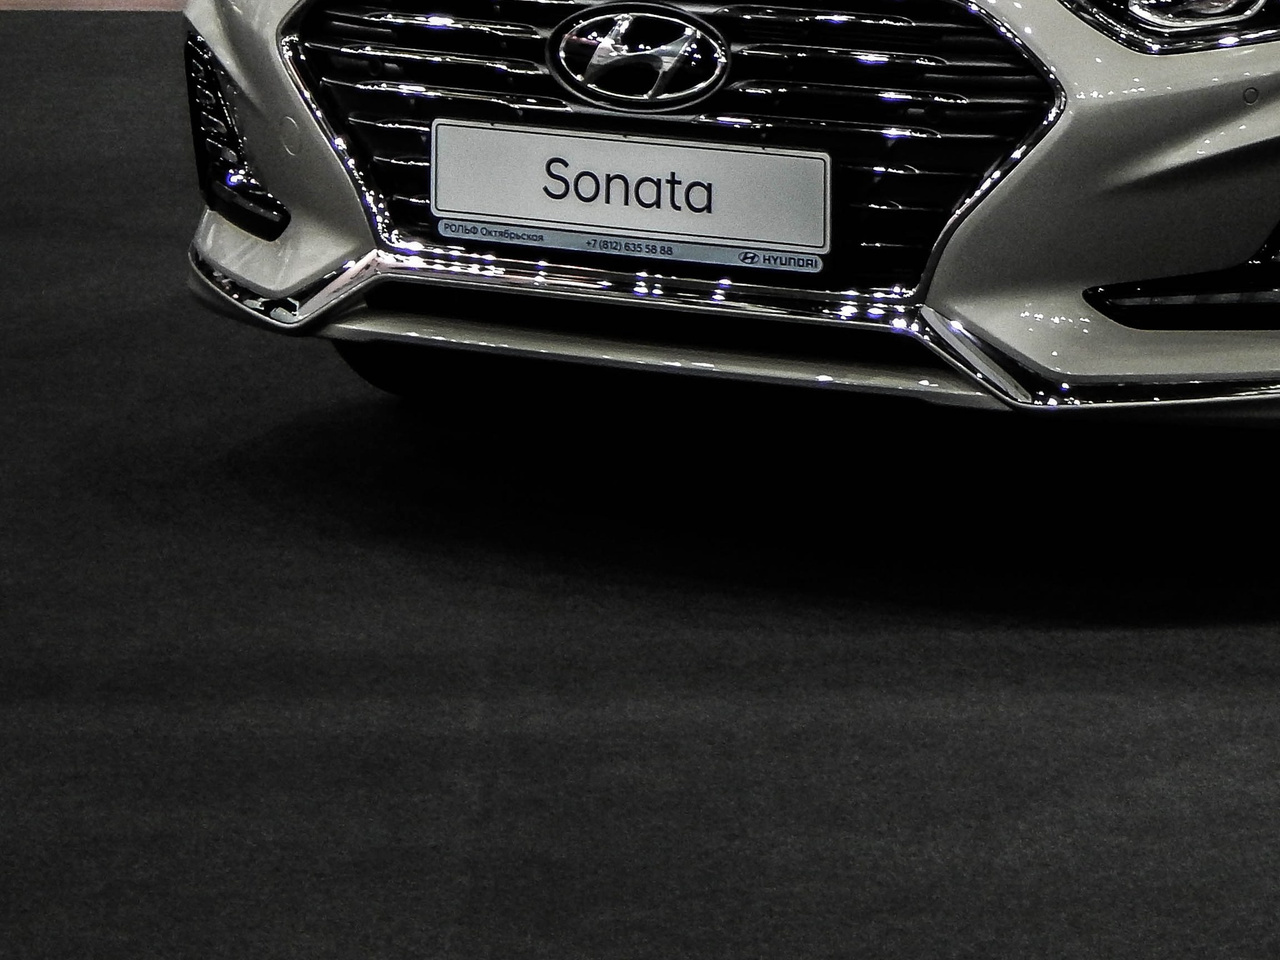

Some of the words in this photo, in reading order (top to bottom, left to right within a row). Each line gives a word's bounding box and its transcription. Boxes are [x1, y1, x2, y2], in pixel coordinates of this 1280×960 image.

[542, 156, 714, 214] Sonata
[443, 222, 479, 236] РОЛЬФ
[480, 227, 544, 242] Октябрьская
[585, 239, 597, 249] +7
[599, 239, 623, 252] (812)
[625, 242, 643, 253] 635
[645, 244, 657, 254] 58
[660, 245, 673, 256] 88
[762, 256, 818, 269] HYUNDAI
